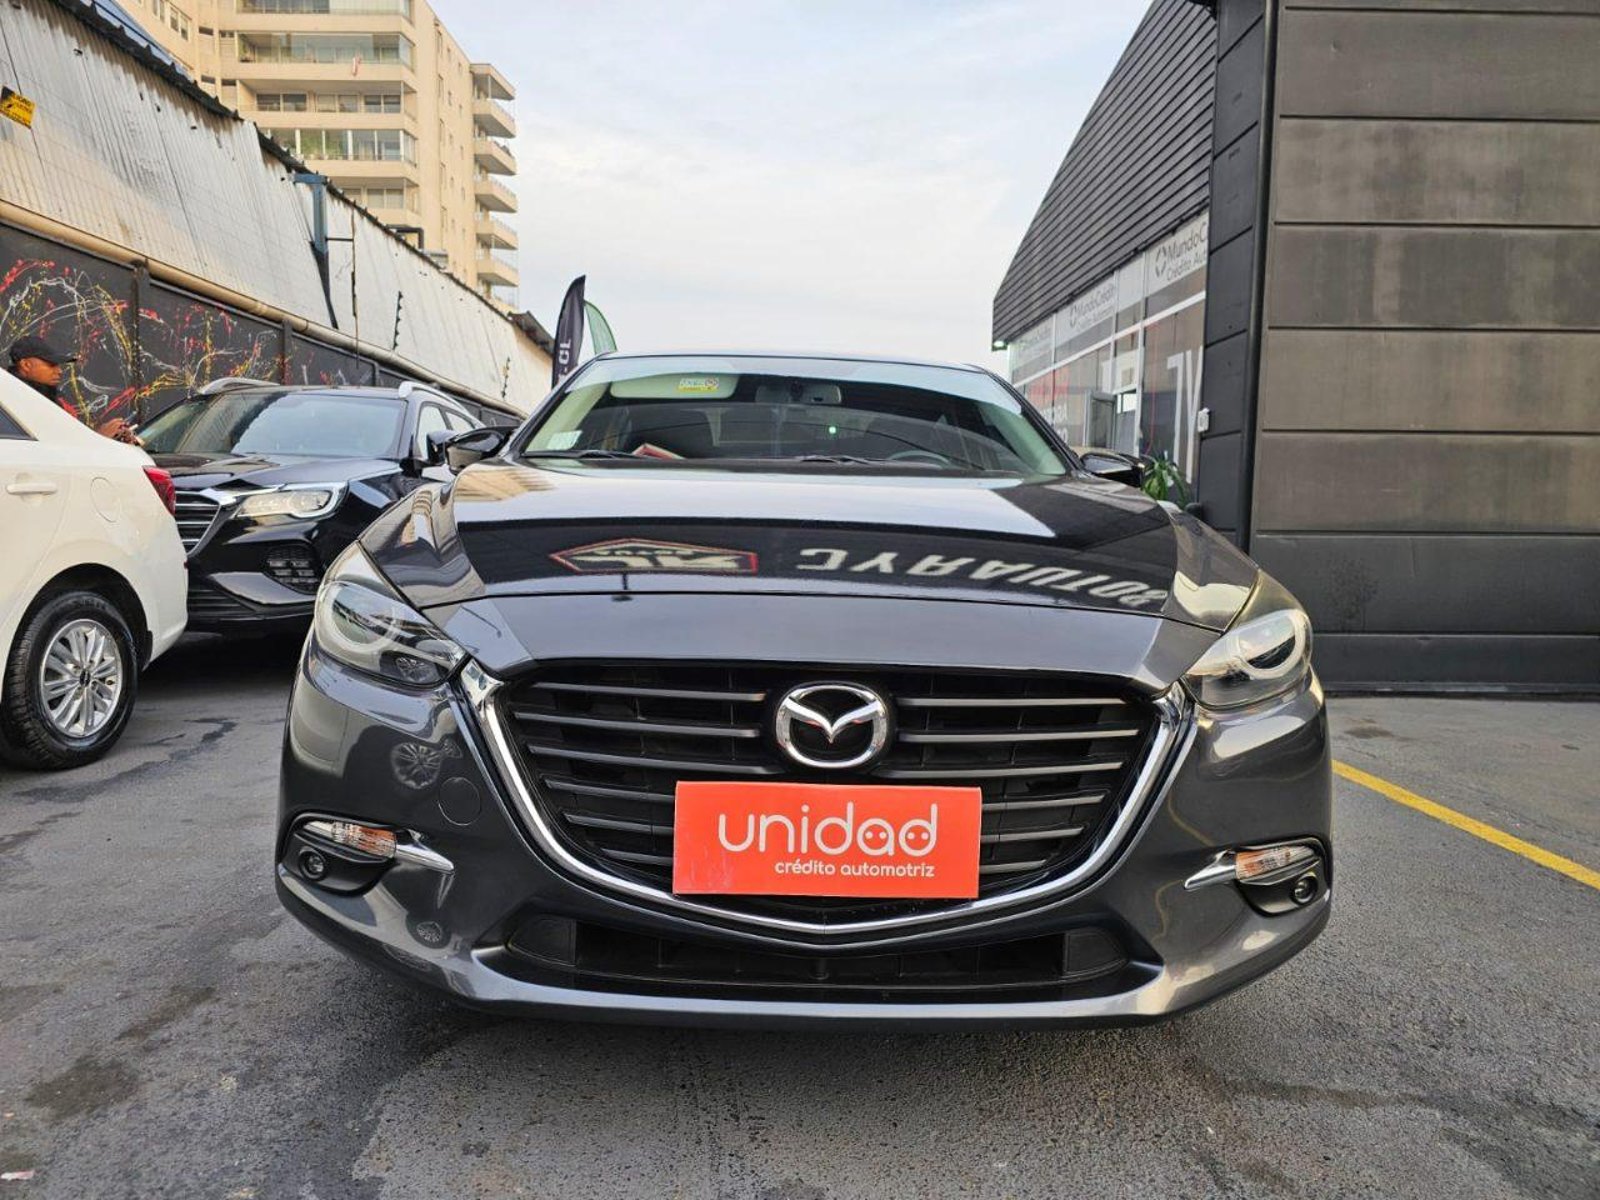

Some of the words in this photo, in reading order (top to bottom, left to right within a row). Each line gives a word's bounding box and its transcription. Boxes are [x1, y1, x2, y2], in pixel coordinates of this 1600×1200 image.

[718, 801, 938, 857] unidad
[774, 857, 836, 876] crédito
[840, 862, 935, 878] automotriz
